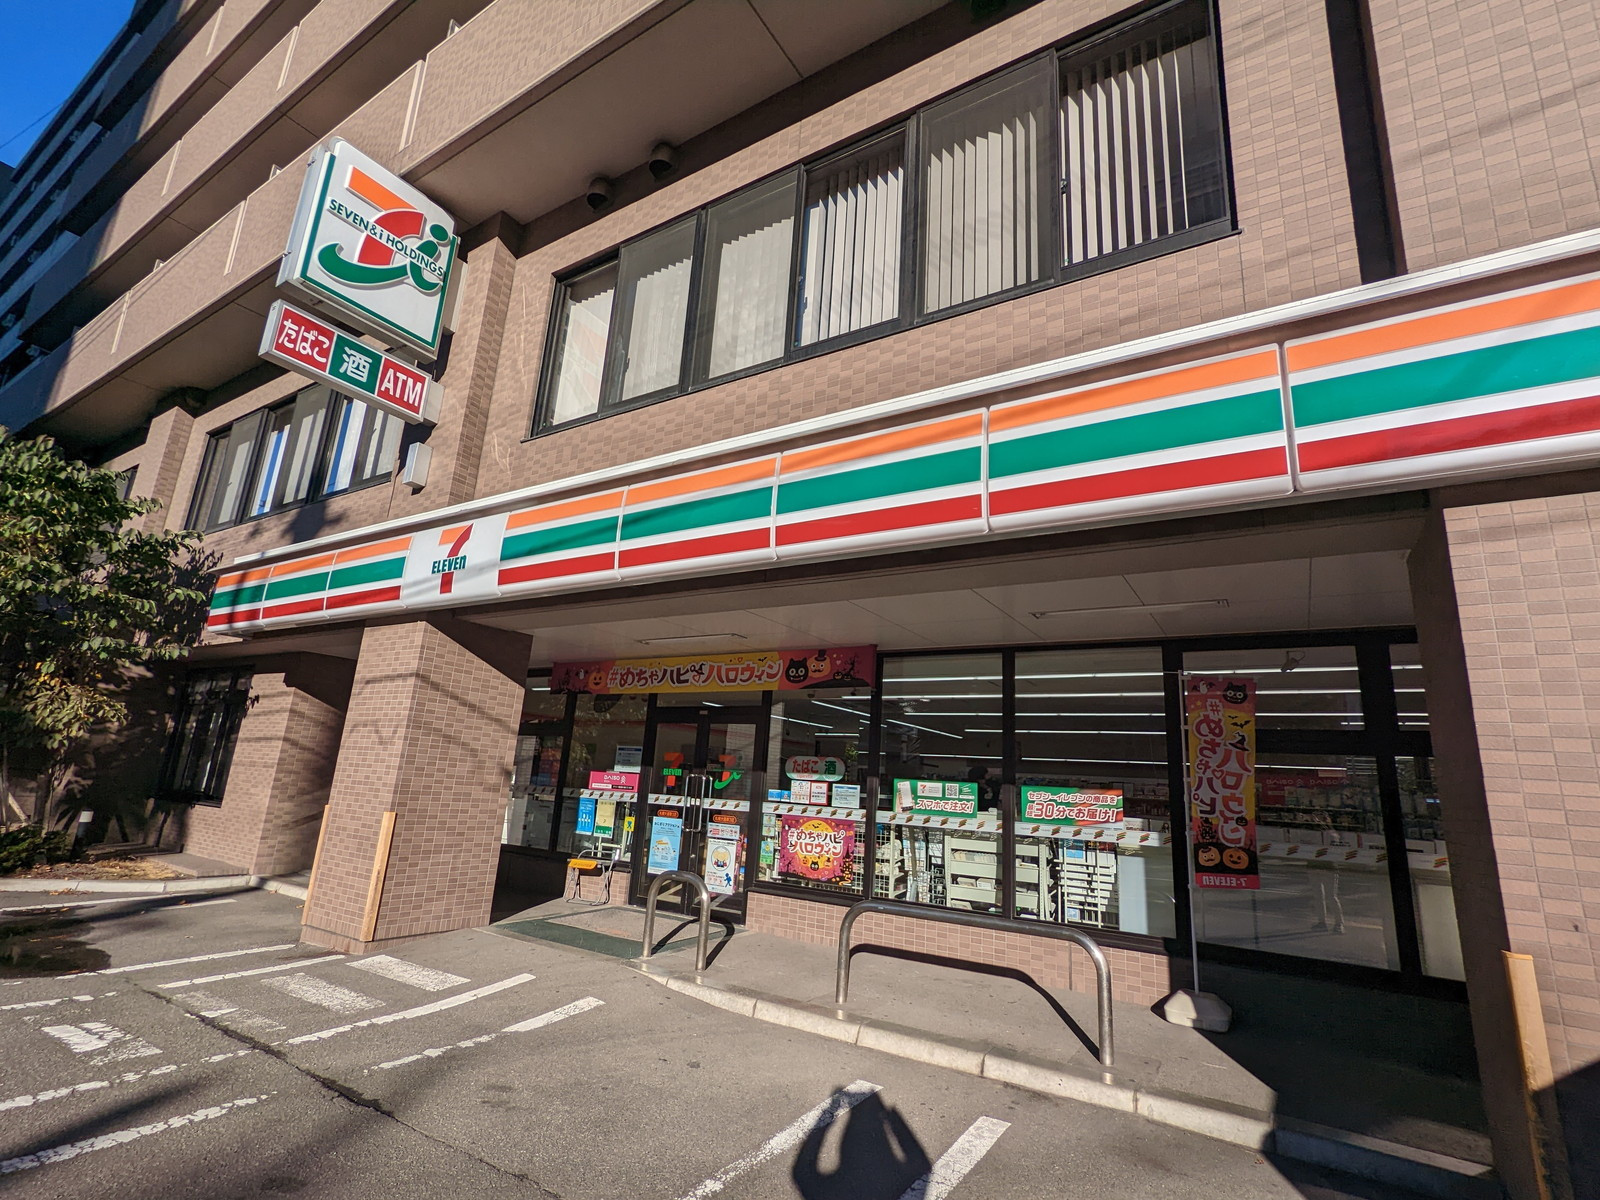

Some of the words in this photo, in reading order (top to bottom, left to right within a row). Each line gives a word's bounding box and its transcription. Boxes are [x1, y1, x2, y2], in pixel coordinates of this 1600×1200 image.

[386, 233, 444, 277] HOLDINGS
[277, 318, 330, 363] たばこ
[339, 346, 373, 383] 酒
[380, 368, 423, 407] ATM
[792, 760, 819, 774] たばこ
[824, 760, 836, 775] 酒
[916, 800, 974, 813] スマホで注文!
